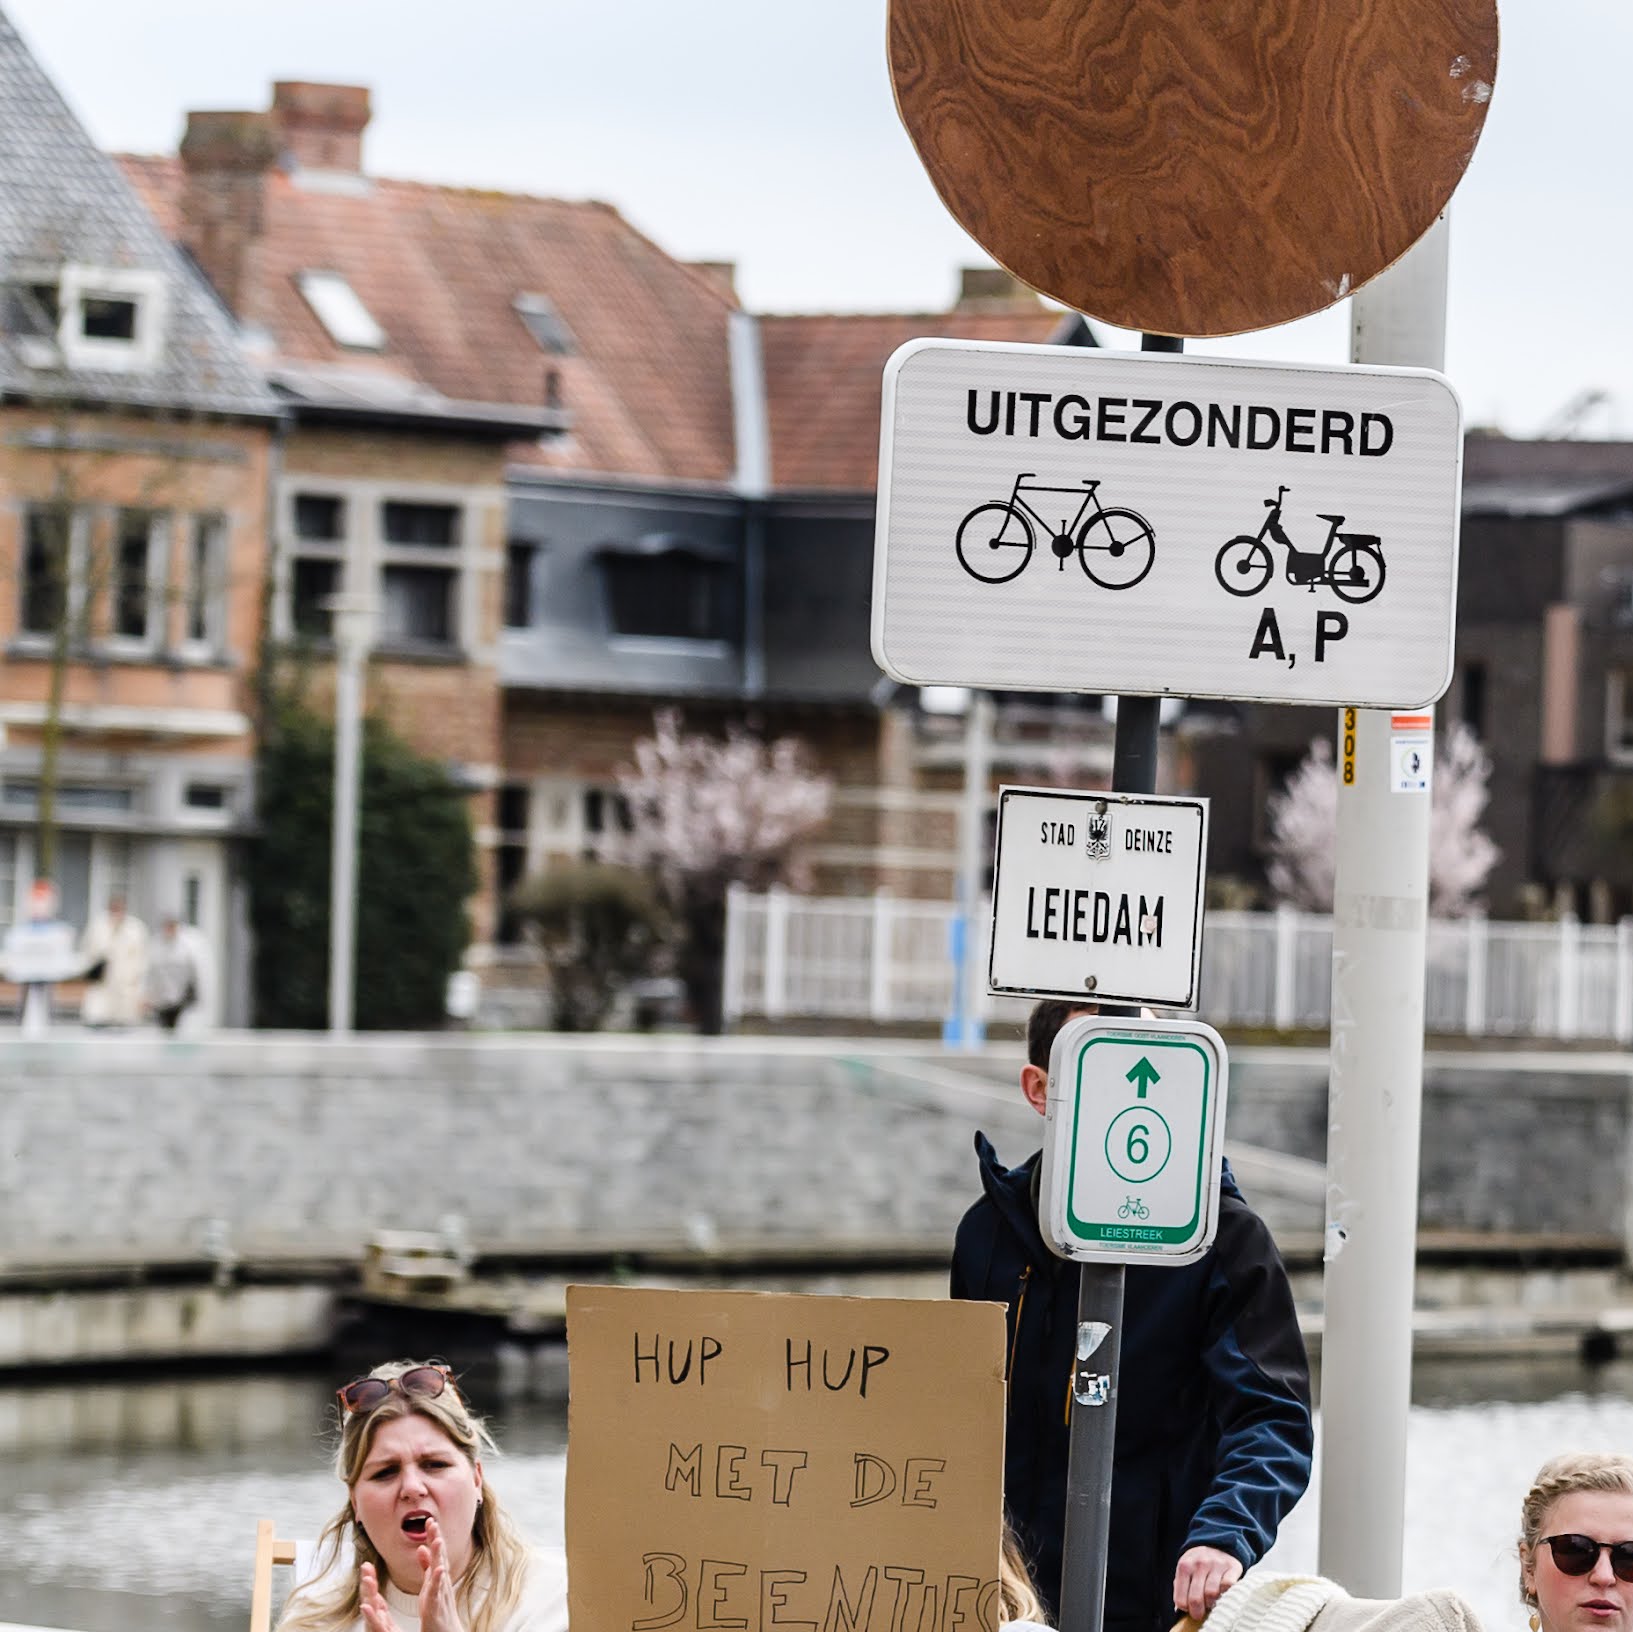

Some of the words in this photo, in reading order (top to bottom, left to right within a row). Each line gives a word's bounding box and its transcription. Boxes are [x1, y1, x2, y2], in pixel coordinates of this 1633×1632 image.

[966, 388, 1394, 457] UITGEZONDERD
[1315, 611, 1349, 663] P
[1040, 821, 1075, 847] STAD
[1124, 828, 1173, 854] DEINZE
[1026, 886, 1165, 948] LEIEDAM
[1125, 1124, 1151, 1165] 6
[1100, 1227, 1164, 1240] LEIESTREEK
[634, 1331, 722, 1385] HUP
[786, 1338, 890, 1398] HUP
[665, 1442, 808, 1507] MET
[849, 1451, 946, 1508] DE
